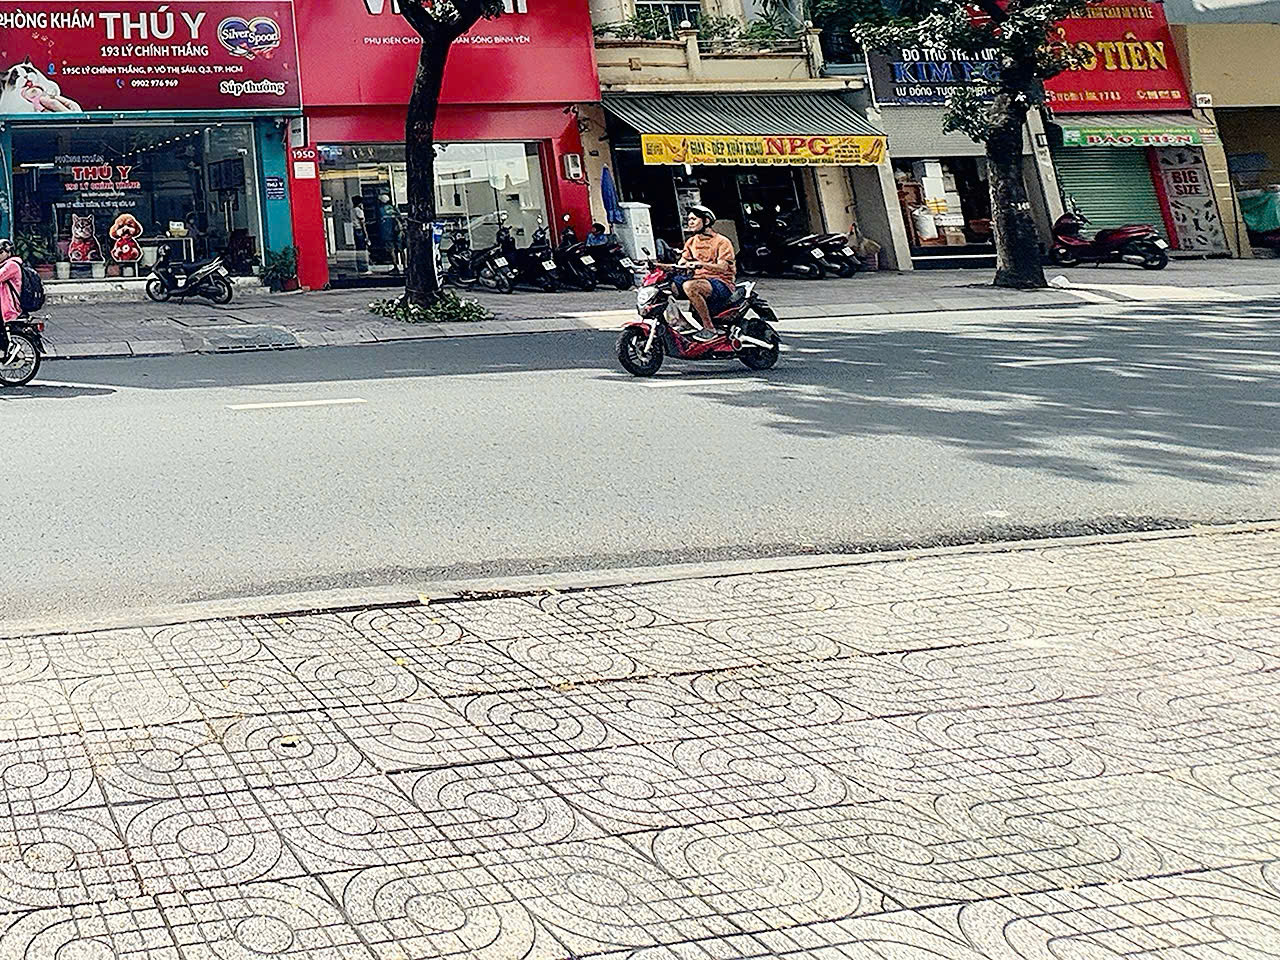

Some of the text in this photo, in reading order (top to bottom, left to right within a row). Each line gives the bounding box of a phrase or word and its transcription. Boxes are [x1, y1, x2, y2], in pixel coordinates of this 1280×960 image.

[50, 8, 94, 29] KHÁM
[99, 5, 175, 40] THÚ
[181, 12, 206, 39] Y
[221, 26, 277, 44] Silver Spoon
[100, 42, 209, 57] 193 LÝ CHÍNH THẮNG
[1097, 32, 1167, 70] TIÊN
[91, 65, 116, 74] CHÍNH
[225, 65, 243, 73] HCM
[892, 61, 956, 82] KIM
[220, 80, 243, 96] Súp
[763, 137, 833, 155] NPG
[72, 162, 132, 180] THÚ Y
[1171, 170, 1199, 183] BIG
[1174, 185, 1201, 195] SIZE
